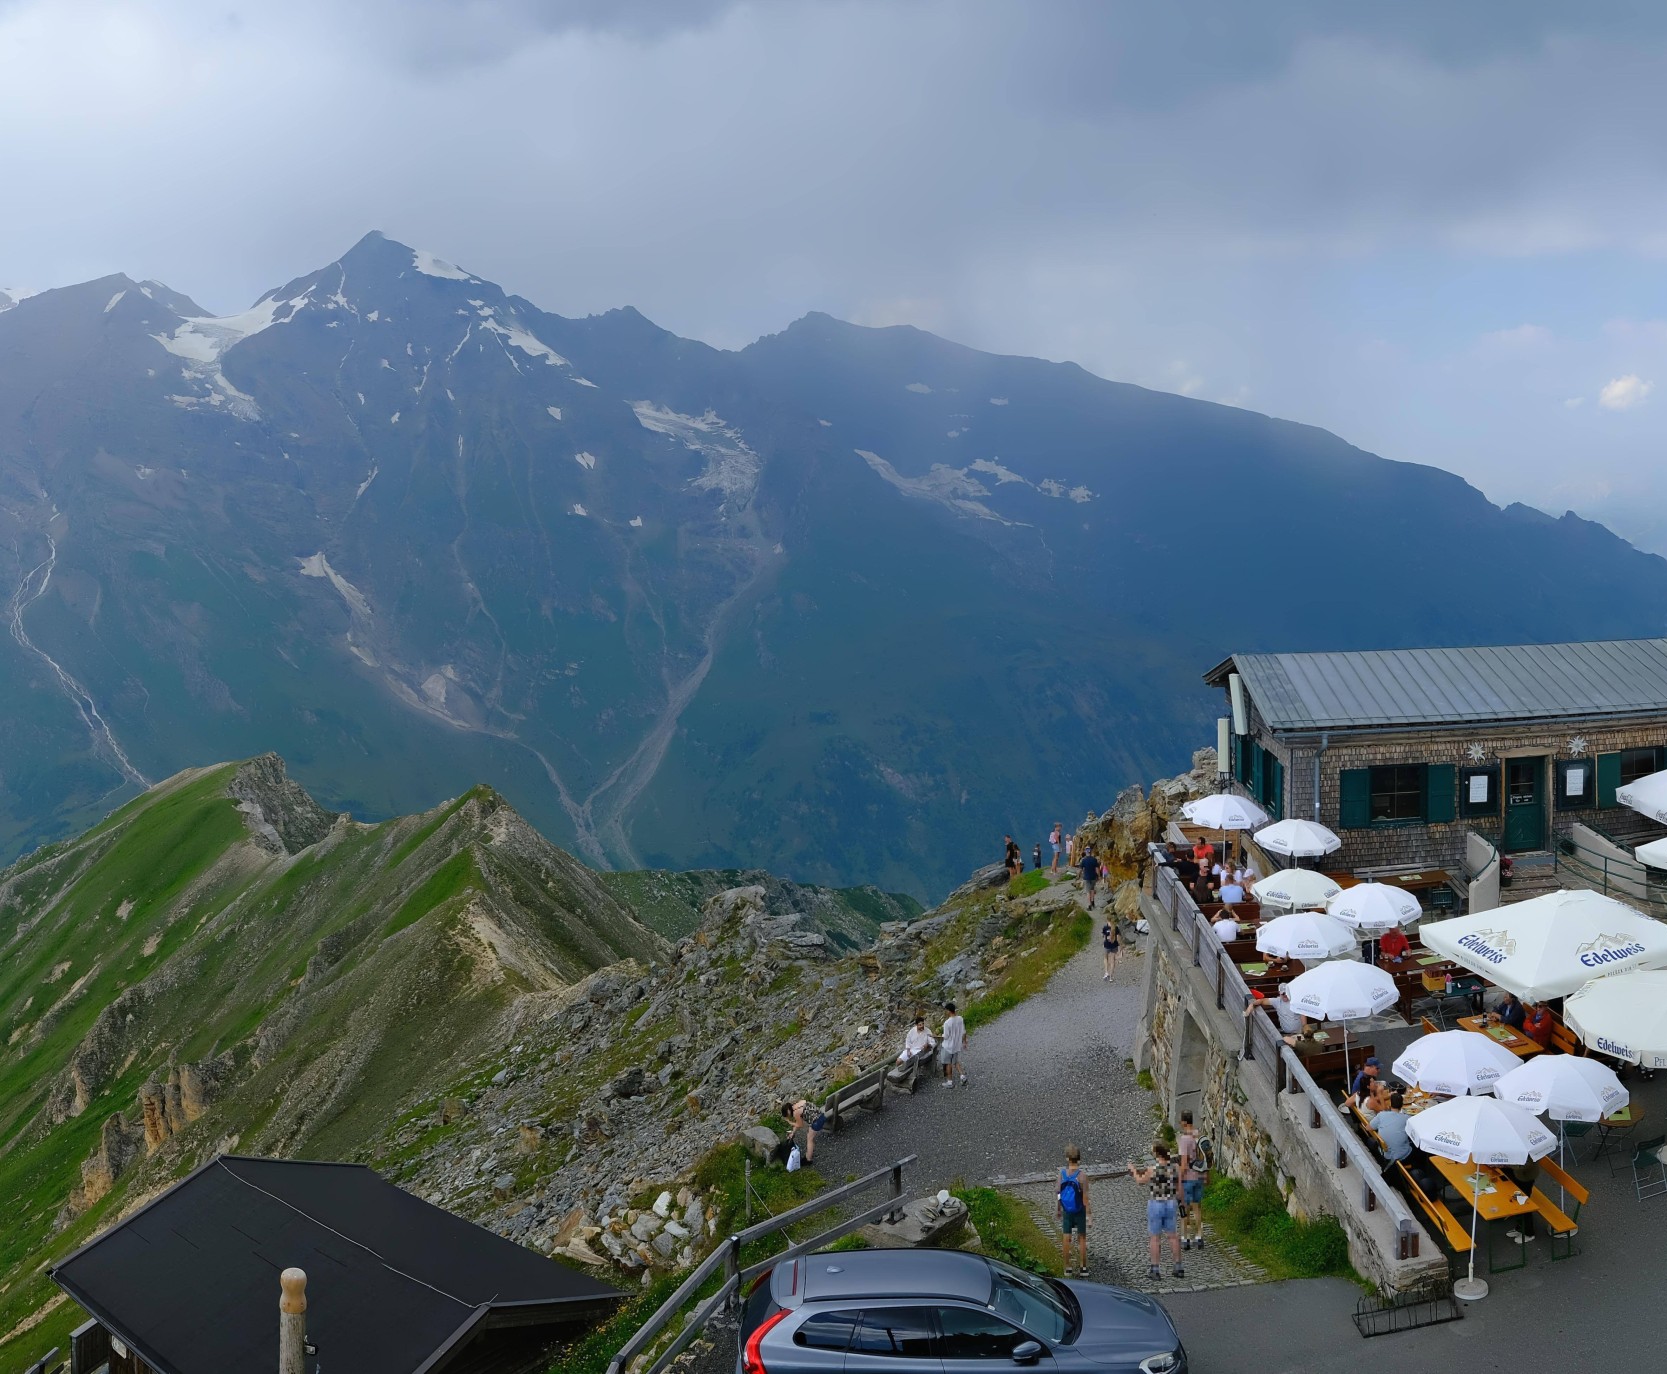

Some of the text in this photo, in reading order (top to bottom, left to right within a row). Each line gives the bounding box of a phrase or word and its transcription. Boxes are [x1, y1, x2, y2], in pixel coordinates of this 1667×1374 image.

[1458, 934, 1508, 964] Edelweiss
[1580, 941, 1646, 968] Edelweiss
[1597, 1037, 1636, 1059] Edelweiss
